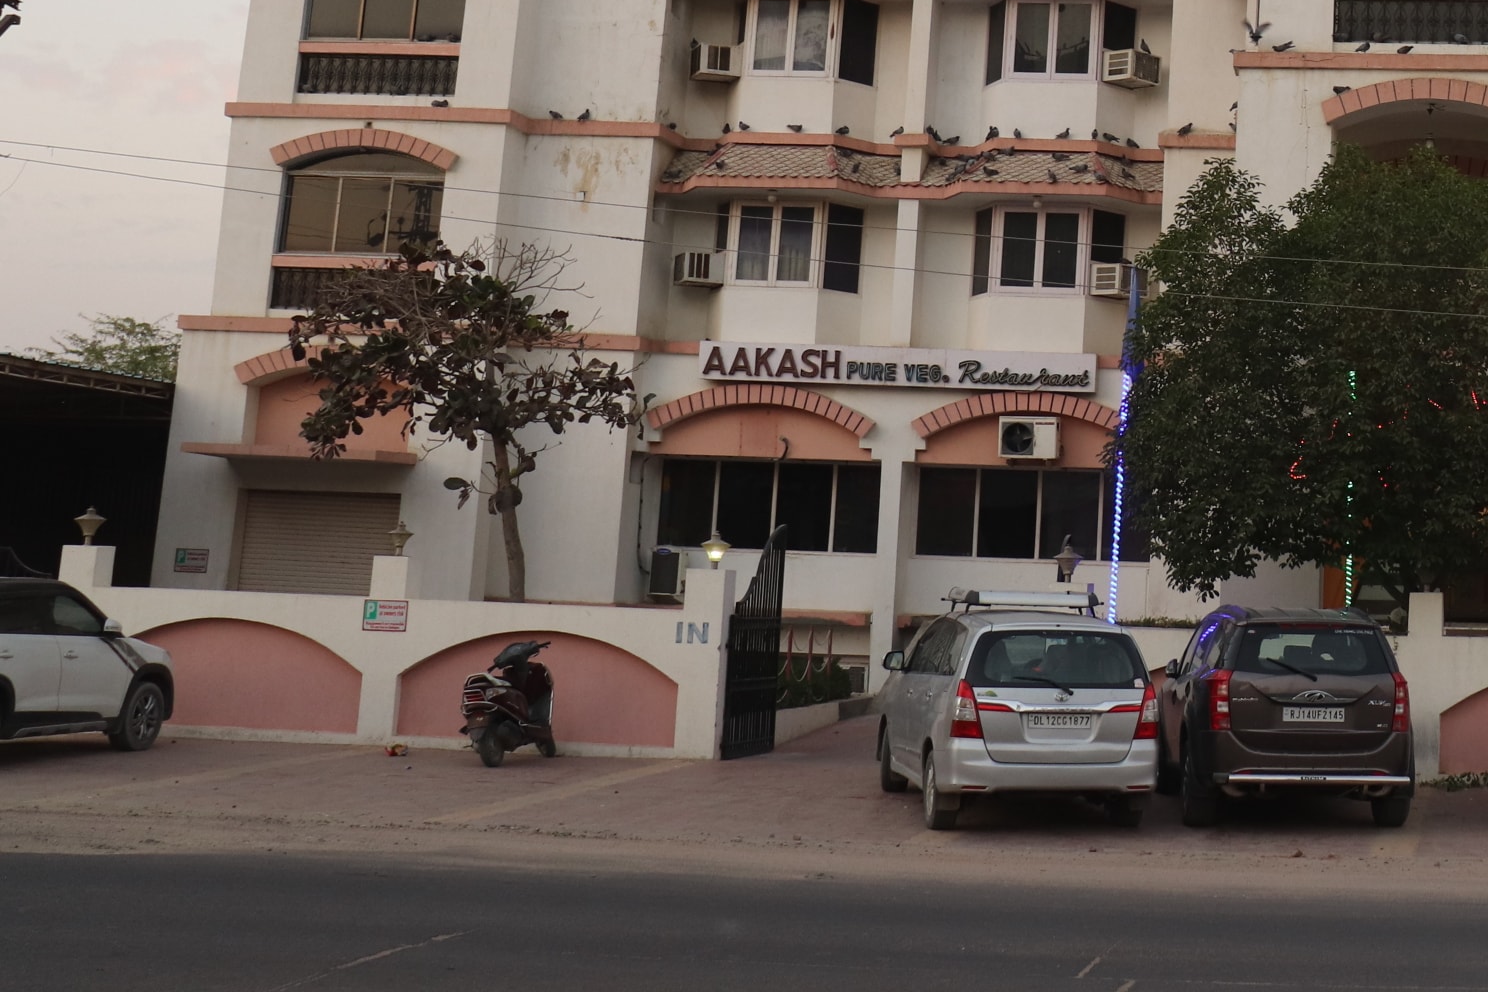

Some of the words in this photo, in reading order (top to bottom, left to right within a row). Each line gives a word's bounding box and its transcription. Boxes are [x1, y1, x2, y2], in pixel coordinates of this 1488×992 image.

[702, 346, 841, 380] AAKASH
[846, 361, 897, 382] PURE
[903, 363, 950, 384] VEG.
[958, 360, 1090, 387] Restaurant
[675, 621, 709, 644] IN
